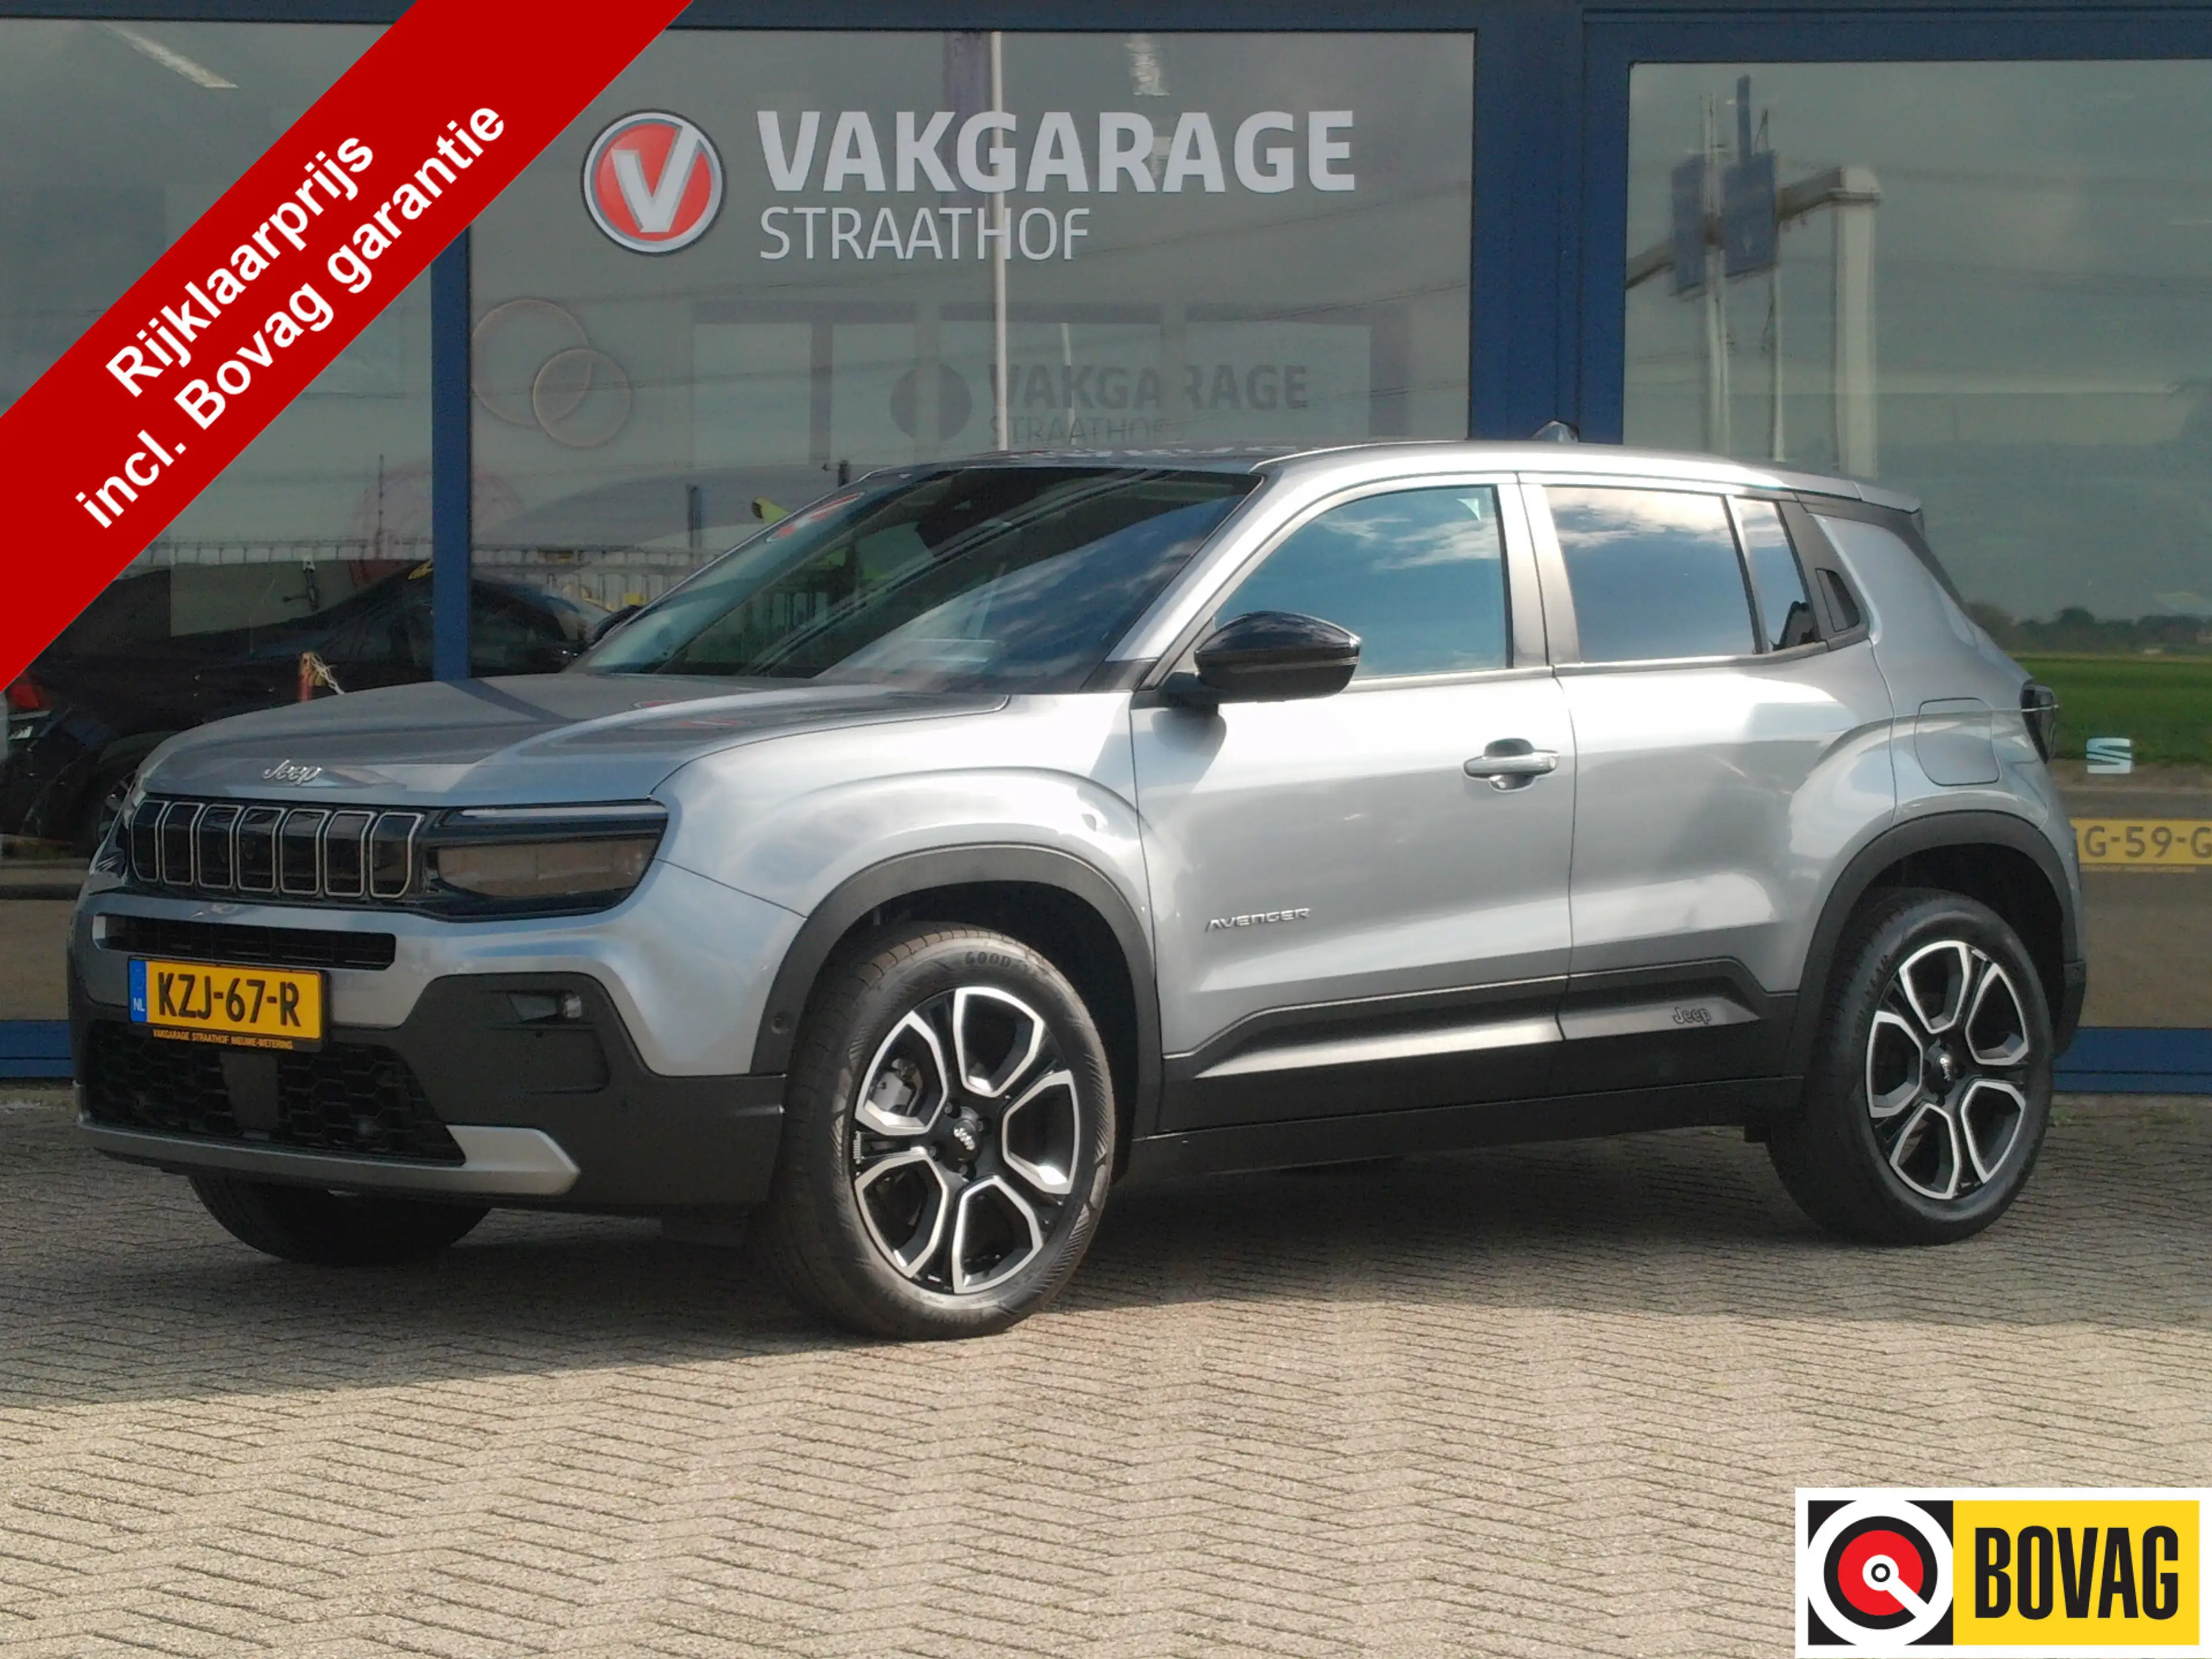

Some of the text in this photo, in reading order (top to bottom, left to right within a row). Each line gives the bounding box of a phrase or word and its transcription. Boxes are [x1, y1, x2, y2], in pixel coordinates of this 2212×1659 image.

[756, 110, 1355, 192] VAKGARAGE
[760, 206, 1090, 260] STRAATHOF
[263, 759, 322, 786] Jeep
[1206, 907, 1310, 932] AVENGER
[133, 997, 145, 1012] NL
[158, 972, 301, 1028] KZJ-67-R
[1673, 1006, 1711, 1025] Jeep
